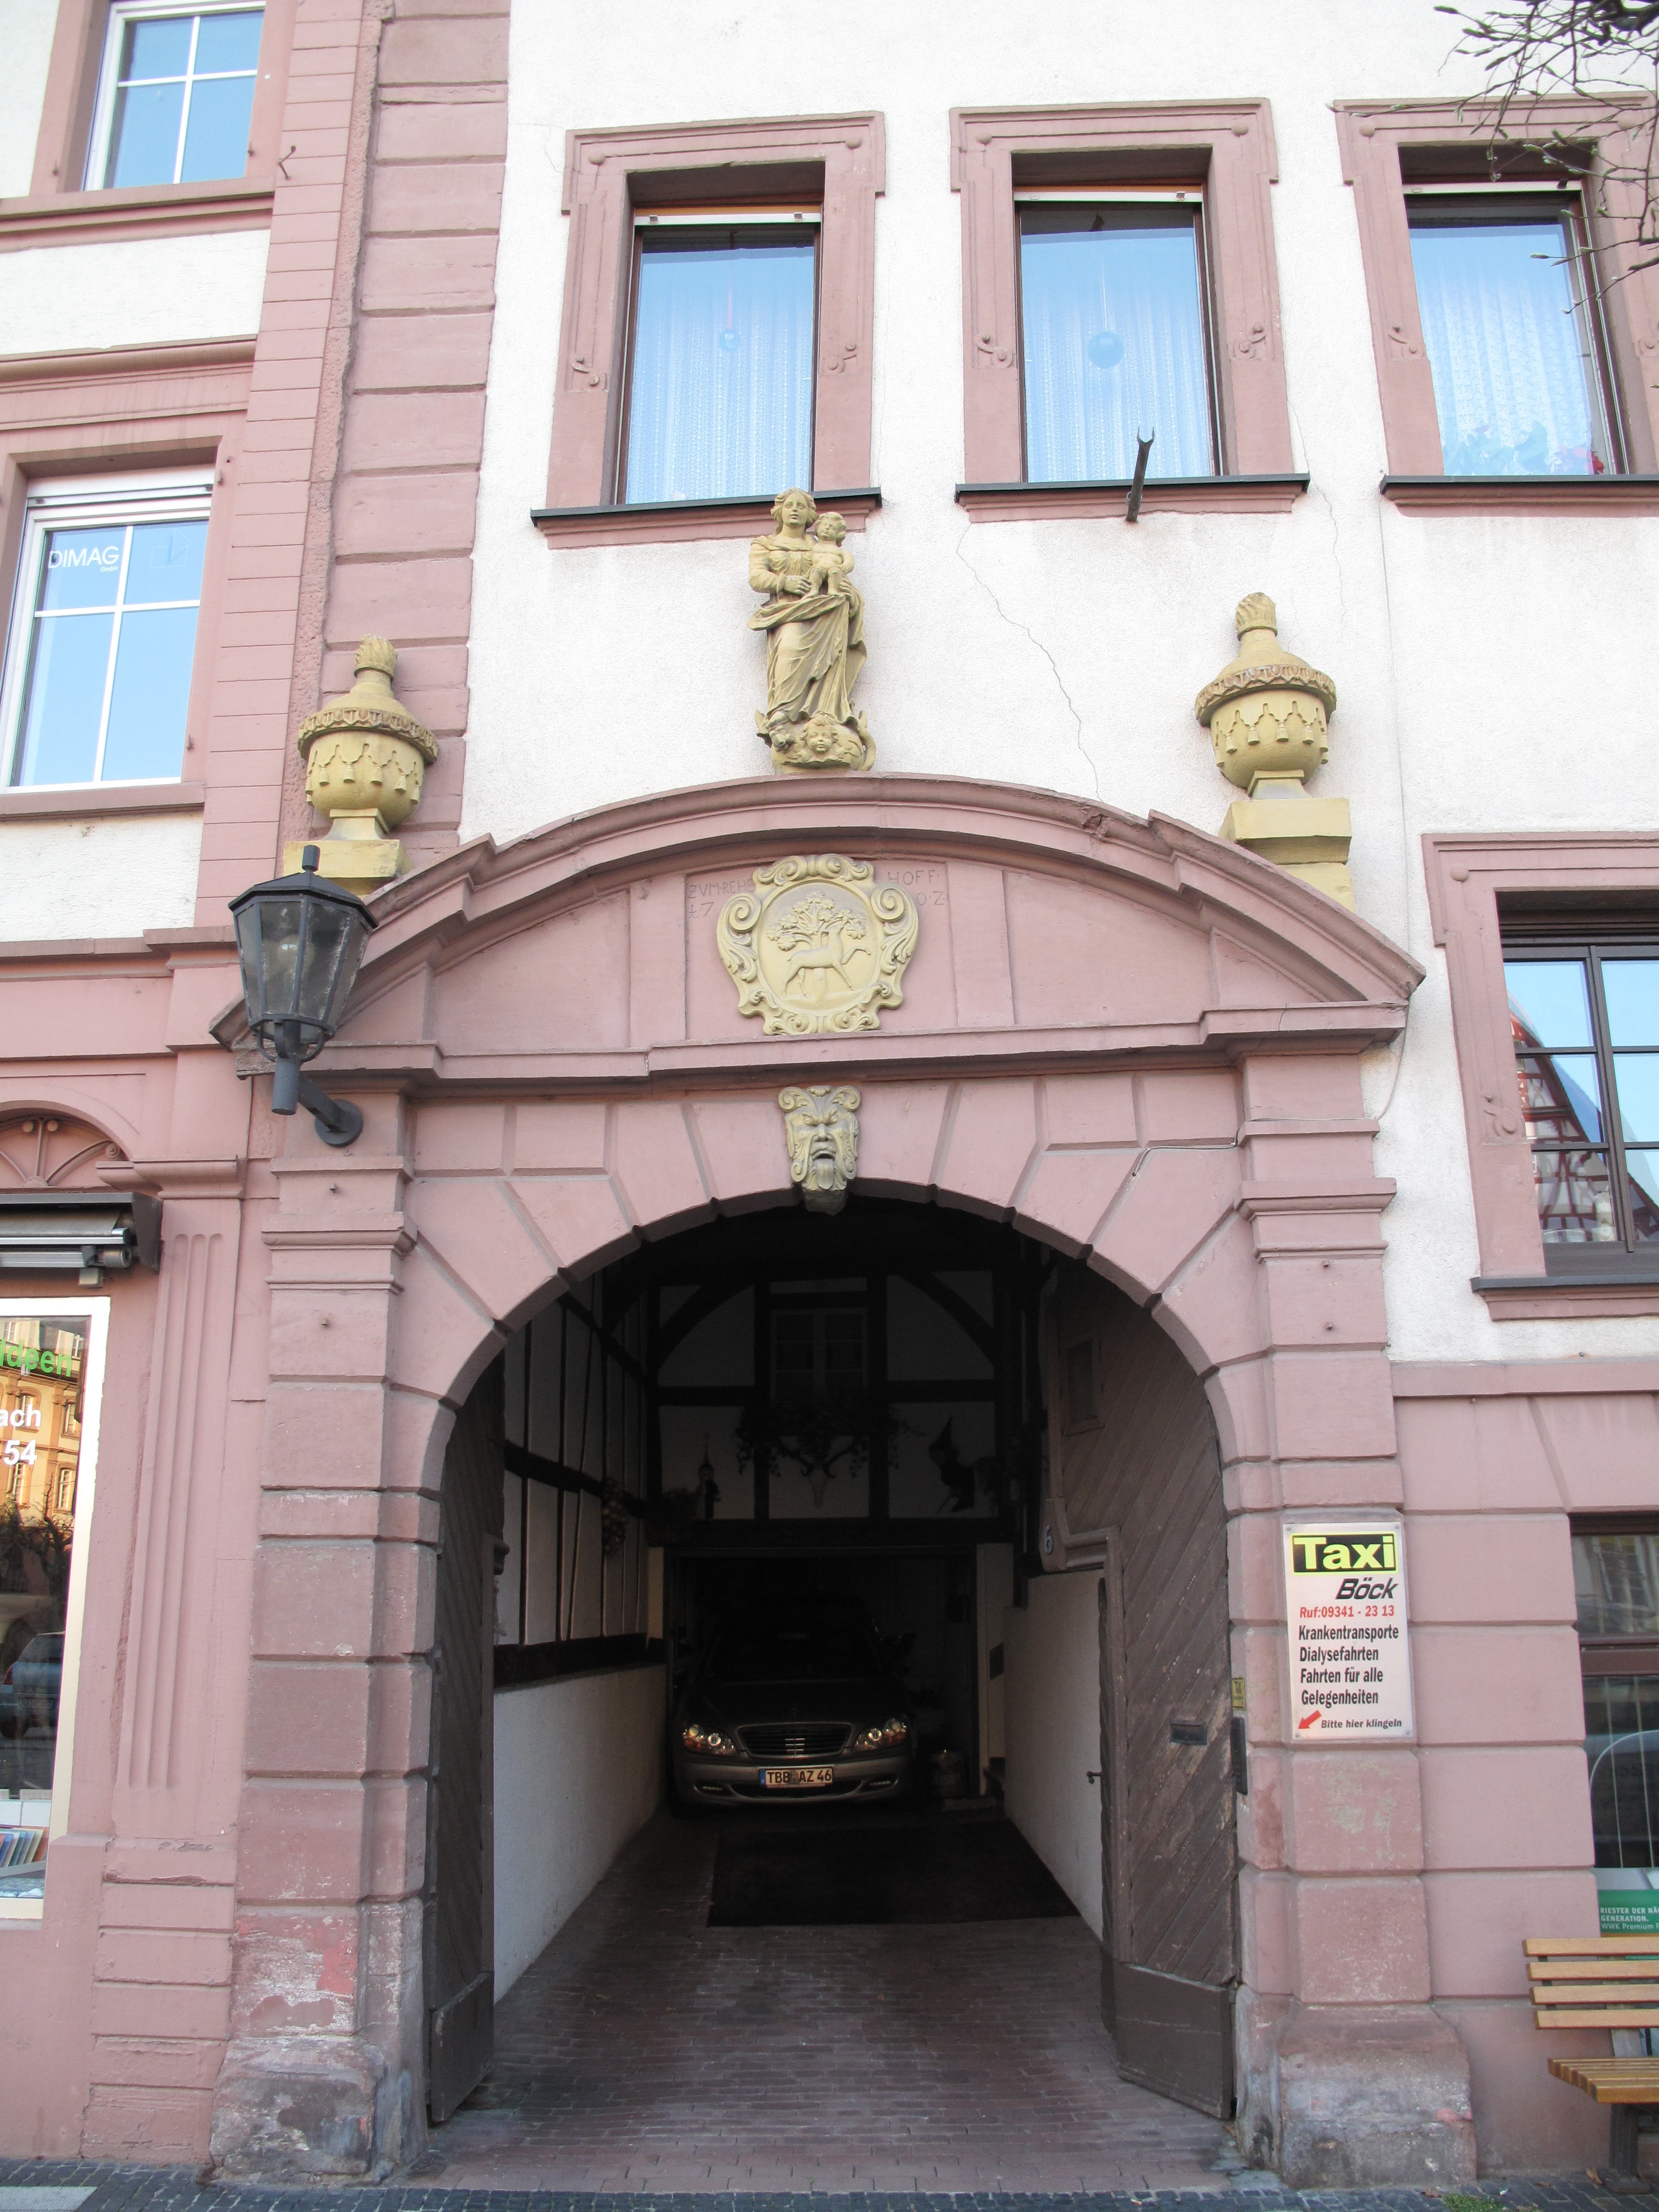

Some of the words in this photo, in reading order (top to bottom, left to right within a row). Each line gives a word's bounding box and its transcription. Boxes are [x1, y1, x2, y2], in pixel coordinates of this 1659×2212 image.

[48, 546, 120, 569] DIMAG
[4, 1439, 37, 1465] 54
[1043, 1524, 1053, 1554] 6
[1293, 1536, 1395, 1569] Taxi
[1335, 1577, 1399, 1599] Böck
[1365, 1605, 1377, 1617] 23
[1382, 1604, 1395, 1616] 13
[1298, 1624, 1399, 1642] Krankentransporte
[1299, 1645, 1378, 1665] Dialysefahrten
[1300, 1668, 1340, 1683] Fahrten
[1344, 1666, 1360, 1683] für
[1363, 1667, 1383, 1683] alle
[1301, 1689, 1378, 1709] Gelegenheiten
[1321, 1720, 1343, 1728] Bitte
[1346, 1719, 1363, 1728] hier
[1366, 1719, 1402, 1729] klingeln
[767, 1771, 790, 1783] TBB
[799, 1770, 814, 1783] AZ
[817, 1769, 832, 1781] 46
